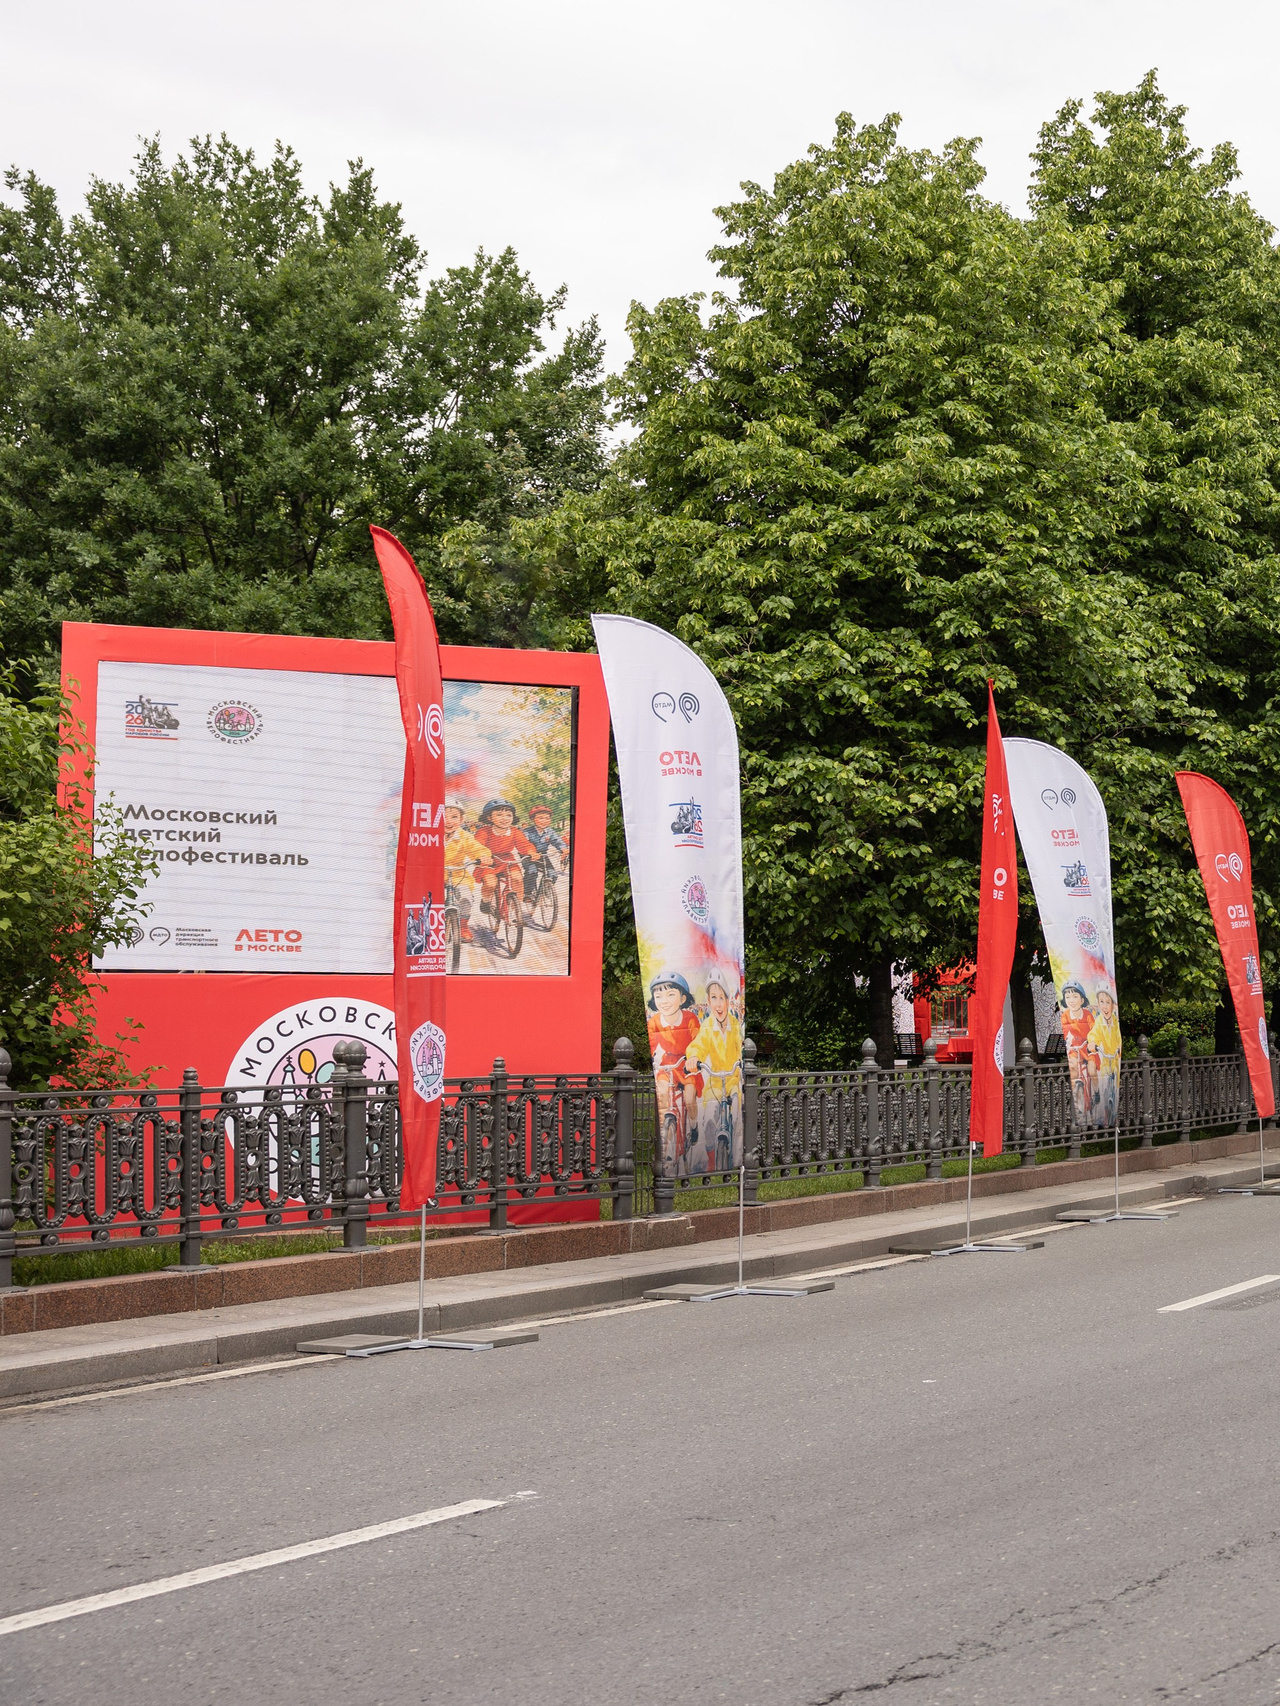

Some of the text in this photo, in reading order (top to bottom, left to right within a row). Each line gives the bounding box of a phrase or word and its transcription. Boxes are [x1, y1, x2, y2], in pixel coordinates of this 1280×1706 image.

[125, 704, 144, 714] 20
[208, 700, 263, 719] МОСКОВСКИЙ
[125, 714, 144, 725] 26
[206, 721, 264, 745] ВЕЛОФЕСТИВАЛЬ
[123, 804, 277, 825] Московский
[122, 828, 221, 843] детский
[124, 846, 309, 866] елофестиваль
[235, 929, 302, 942] ЛЕТО
